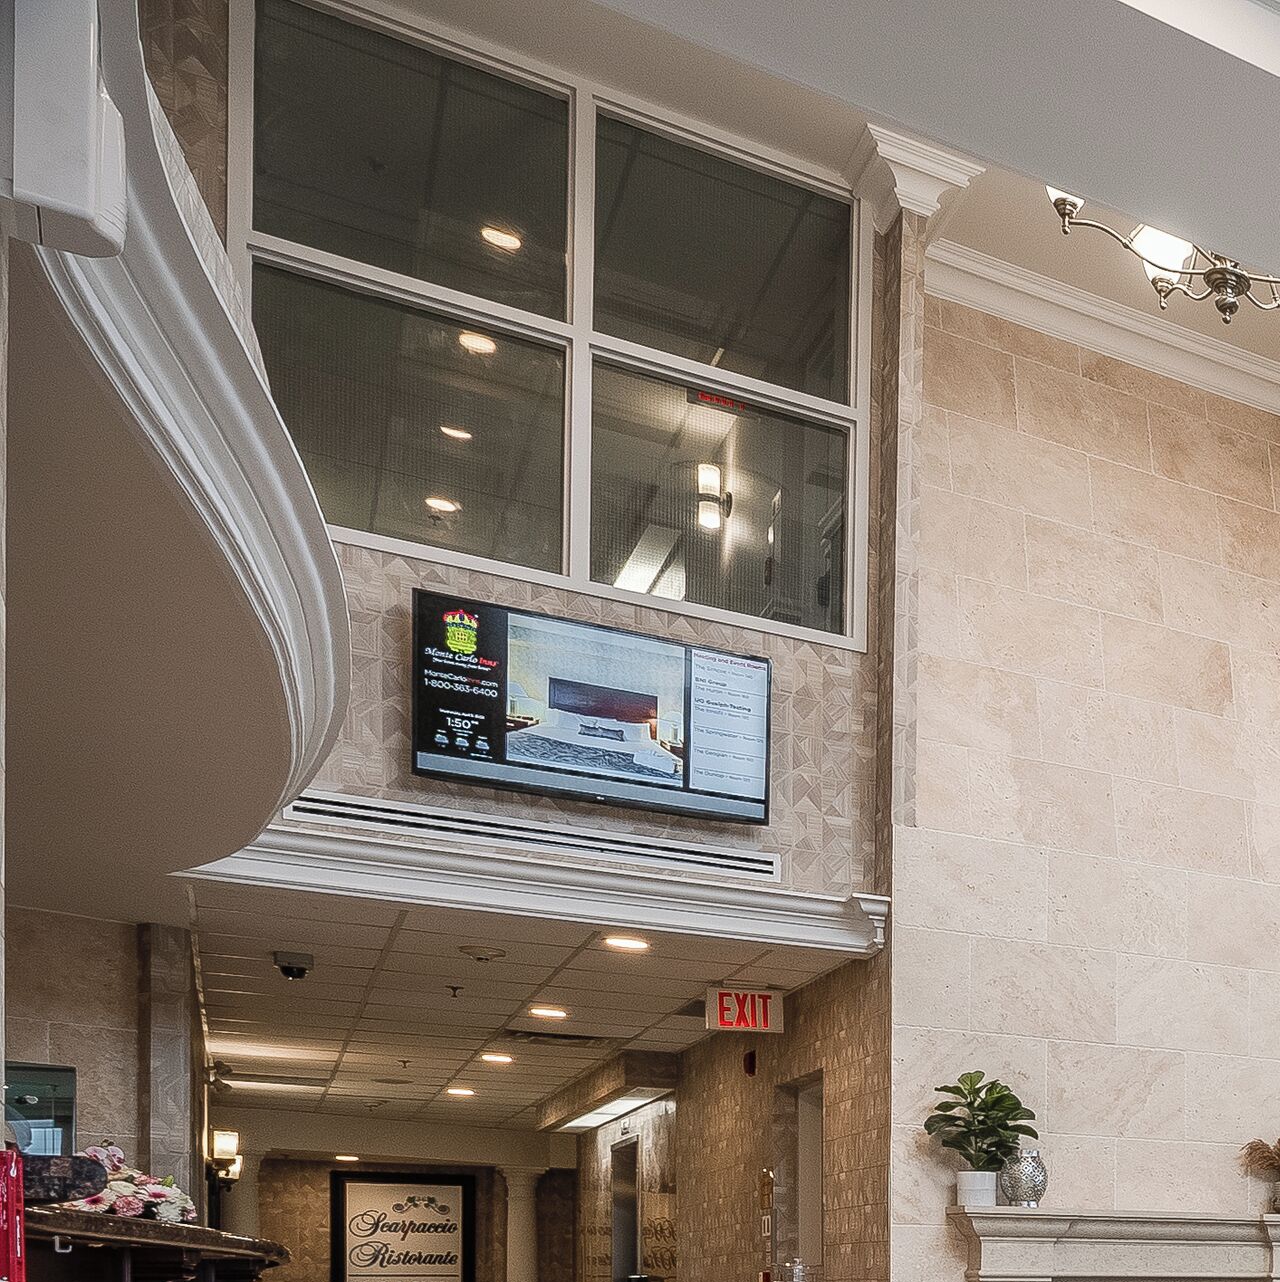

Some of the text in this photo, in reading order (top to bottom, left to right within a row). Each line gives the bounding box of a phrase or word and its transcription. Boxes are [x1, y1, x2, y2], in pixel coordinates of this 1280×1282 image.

[425, 647, 453, 659] Monte
[455, 653, 478, 663] Carlo
[446, 717, 471, 729] 1:50
[718, 991, 772, 1028] EXIT
[349, 1210, 458, 1241] Scarpaccio
[349, 1241, 458, 1268] Ristorante
